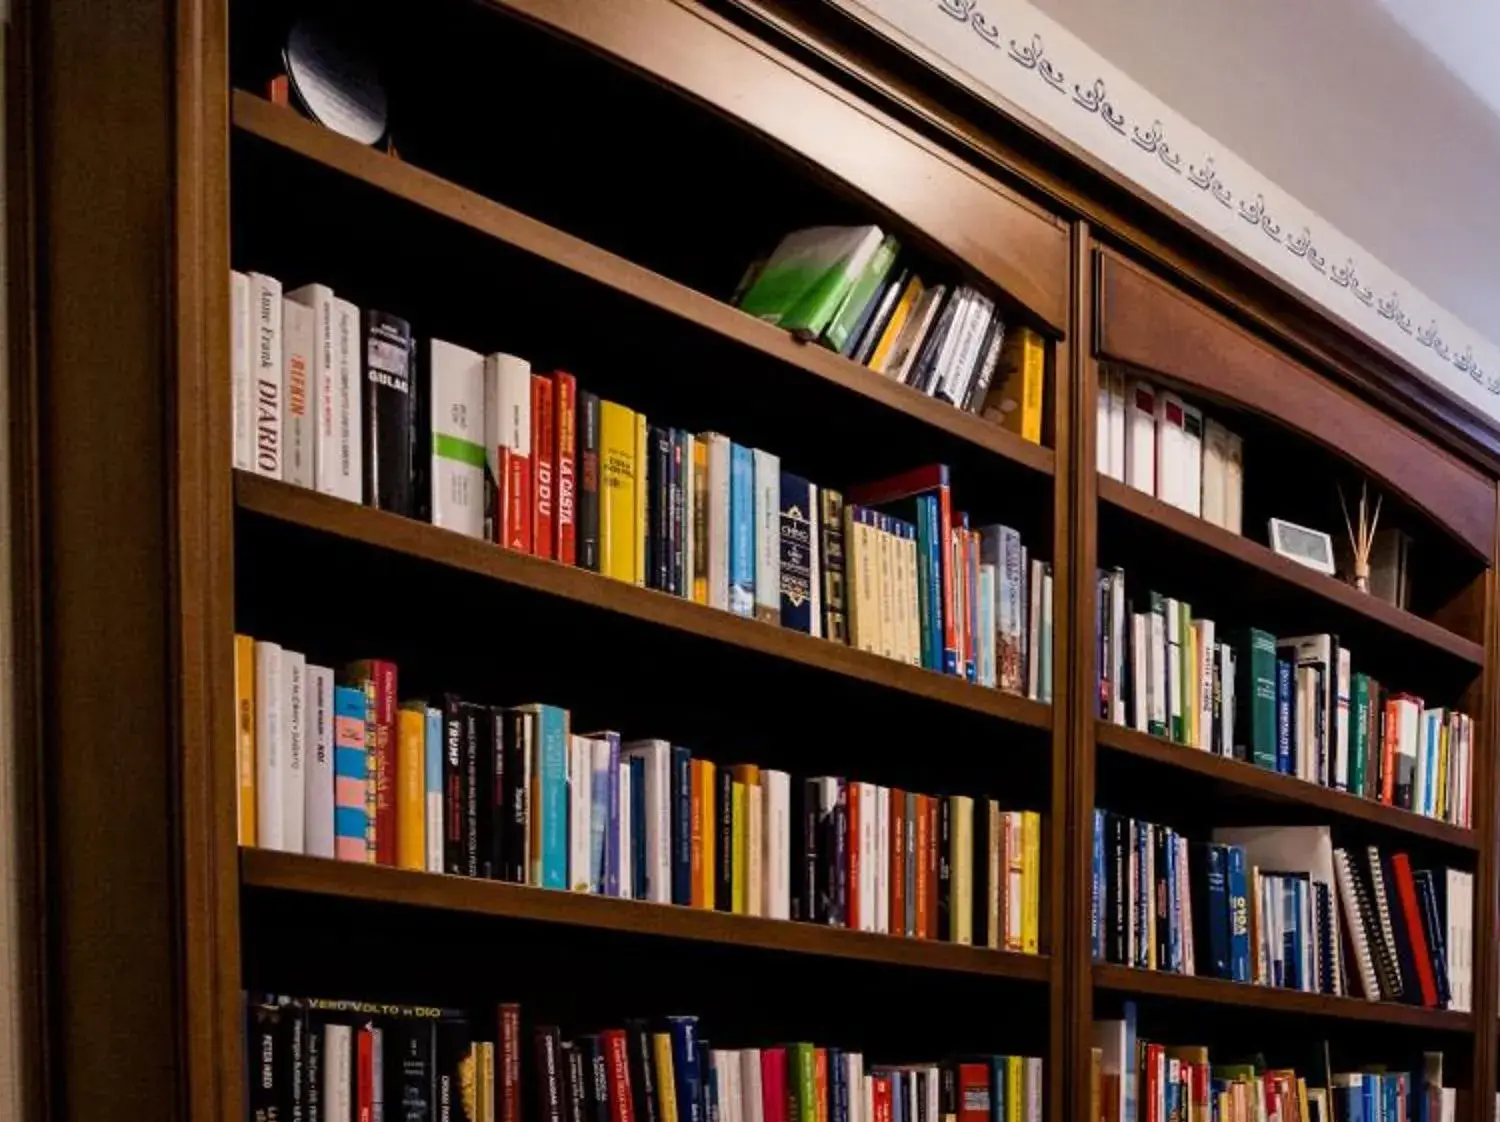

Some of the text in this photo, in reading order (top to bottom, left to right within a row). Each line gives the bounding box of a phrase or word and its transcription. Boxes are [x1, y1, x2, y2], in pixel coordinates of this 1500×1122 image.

[257, 286, 278, 472] Anne Frank DIARIO
[368, 370, 409, 394] GULAG
[539, 461, 551, 516] IDDU
[560, 457, 574, 475] LA
[560, 479, 574, 524] CASTA
[449, 720, 460, 766] TRUMP
[350, 1001, 399, 1014] VOLTO
